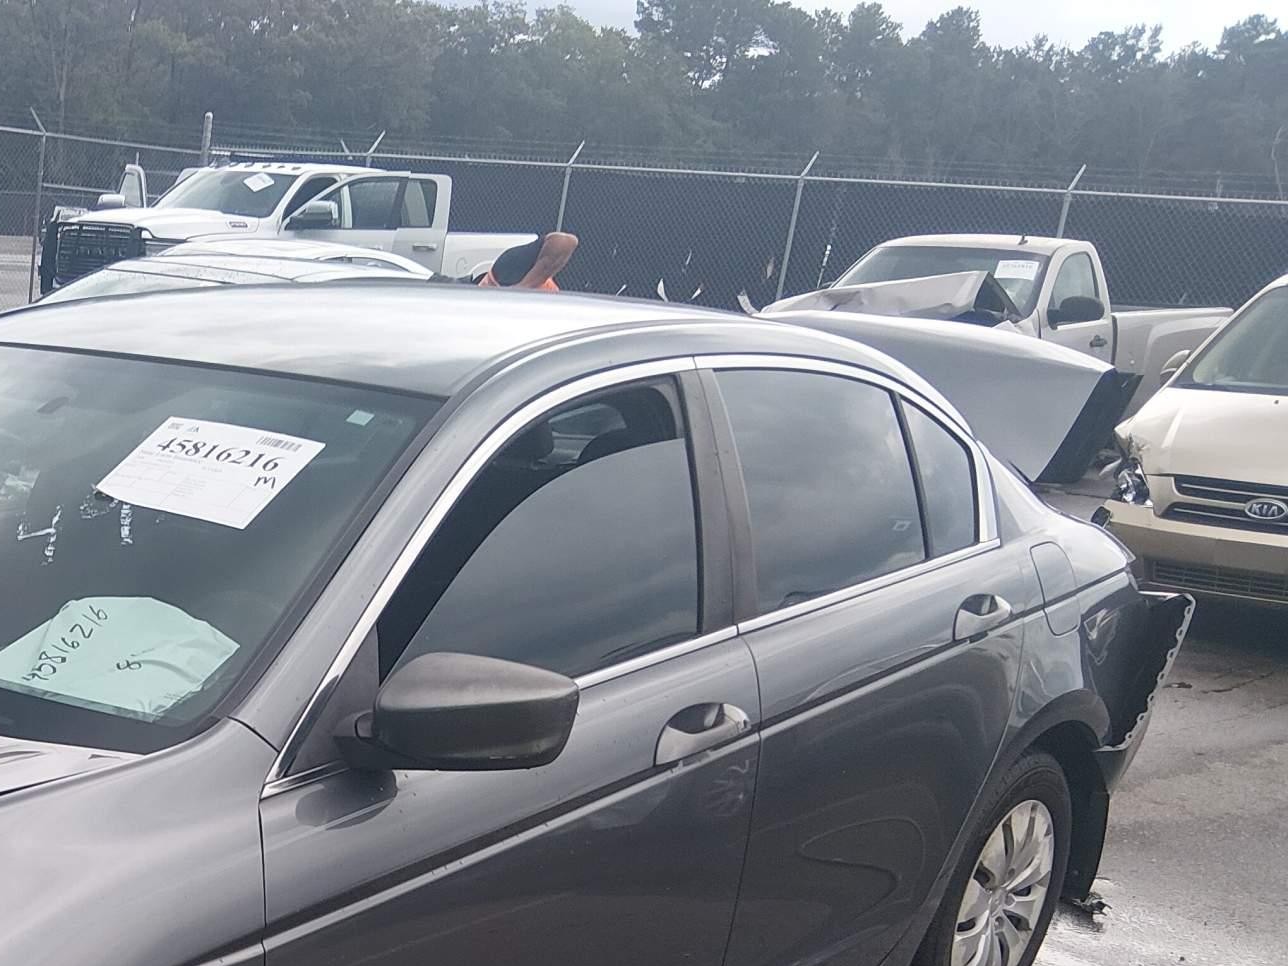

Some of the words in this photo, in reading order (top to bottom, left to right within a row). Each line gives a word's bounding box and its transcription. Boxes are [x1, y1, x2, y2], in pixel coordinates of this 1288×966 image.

[157, 437, 281, 472] 45816216
[1250, 503, 1279, 517] KIA
[22, 604, 109, 681] 45816216
